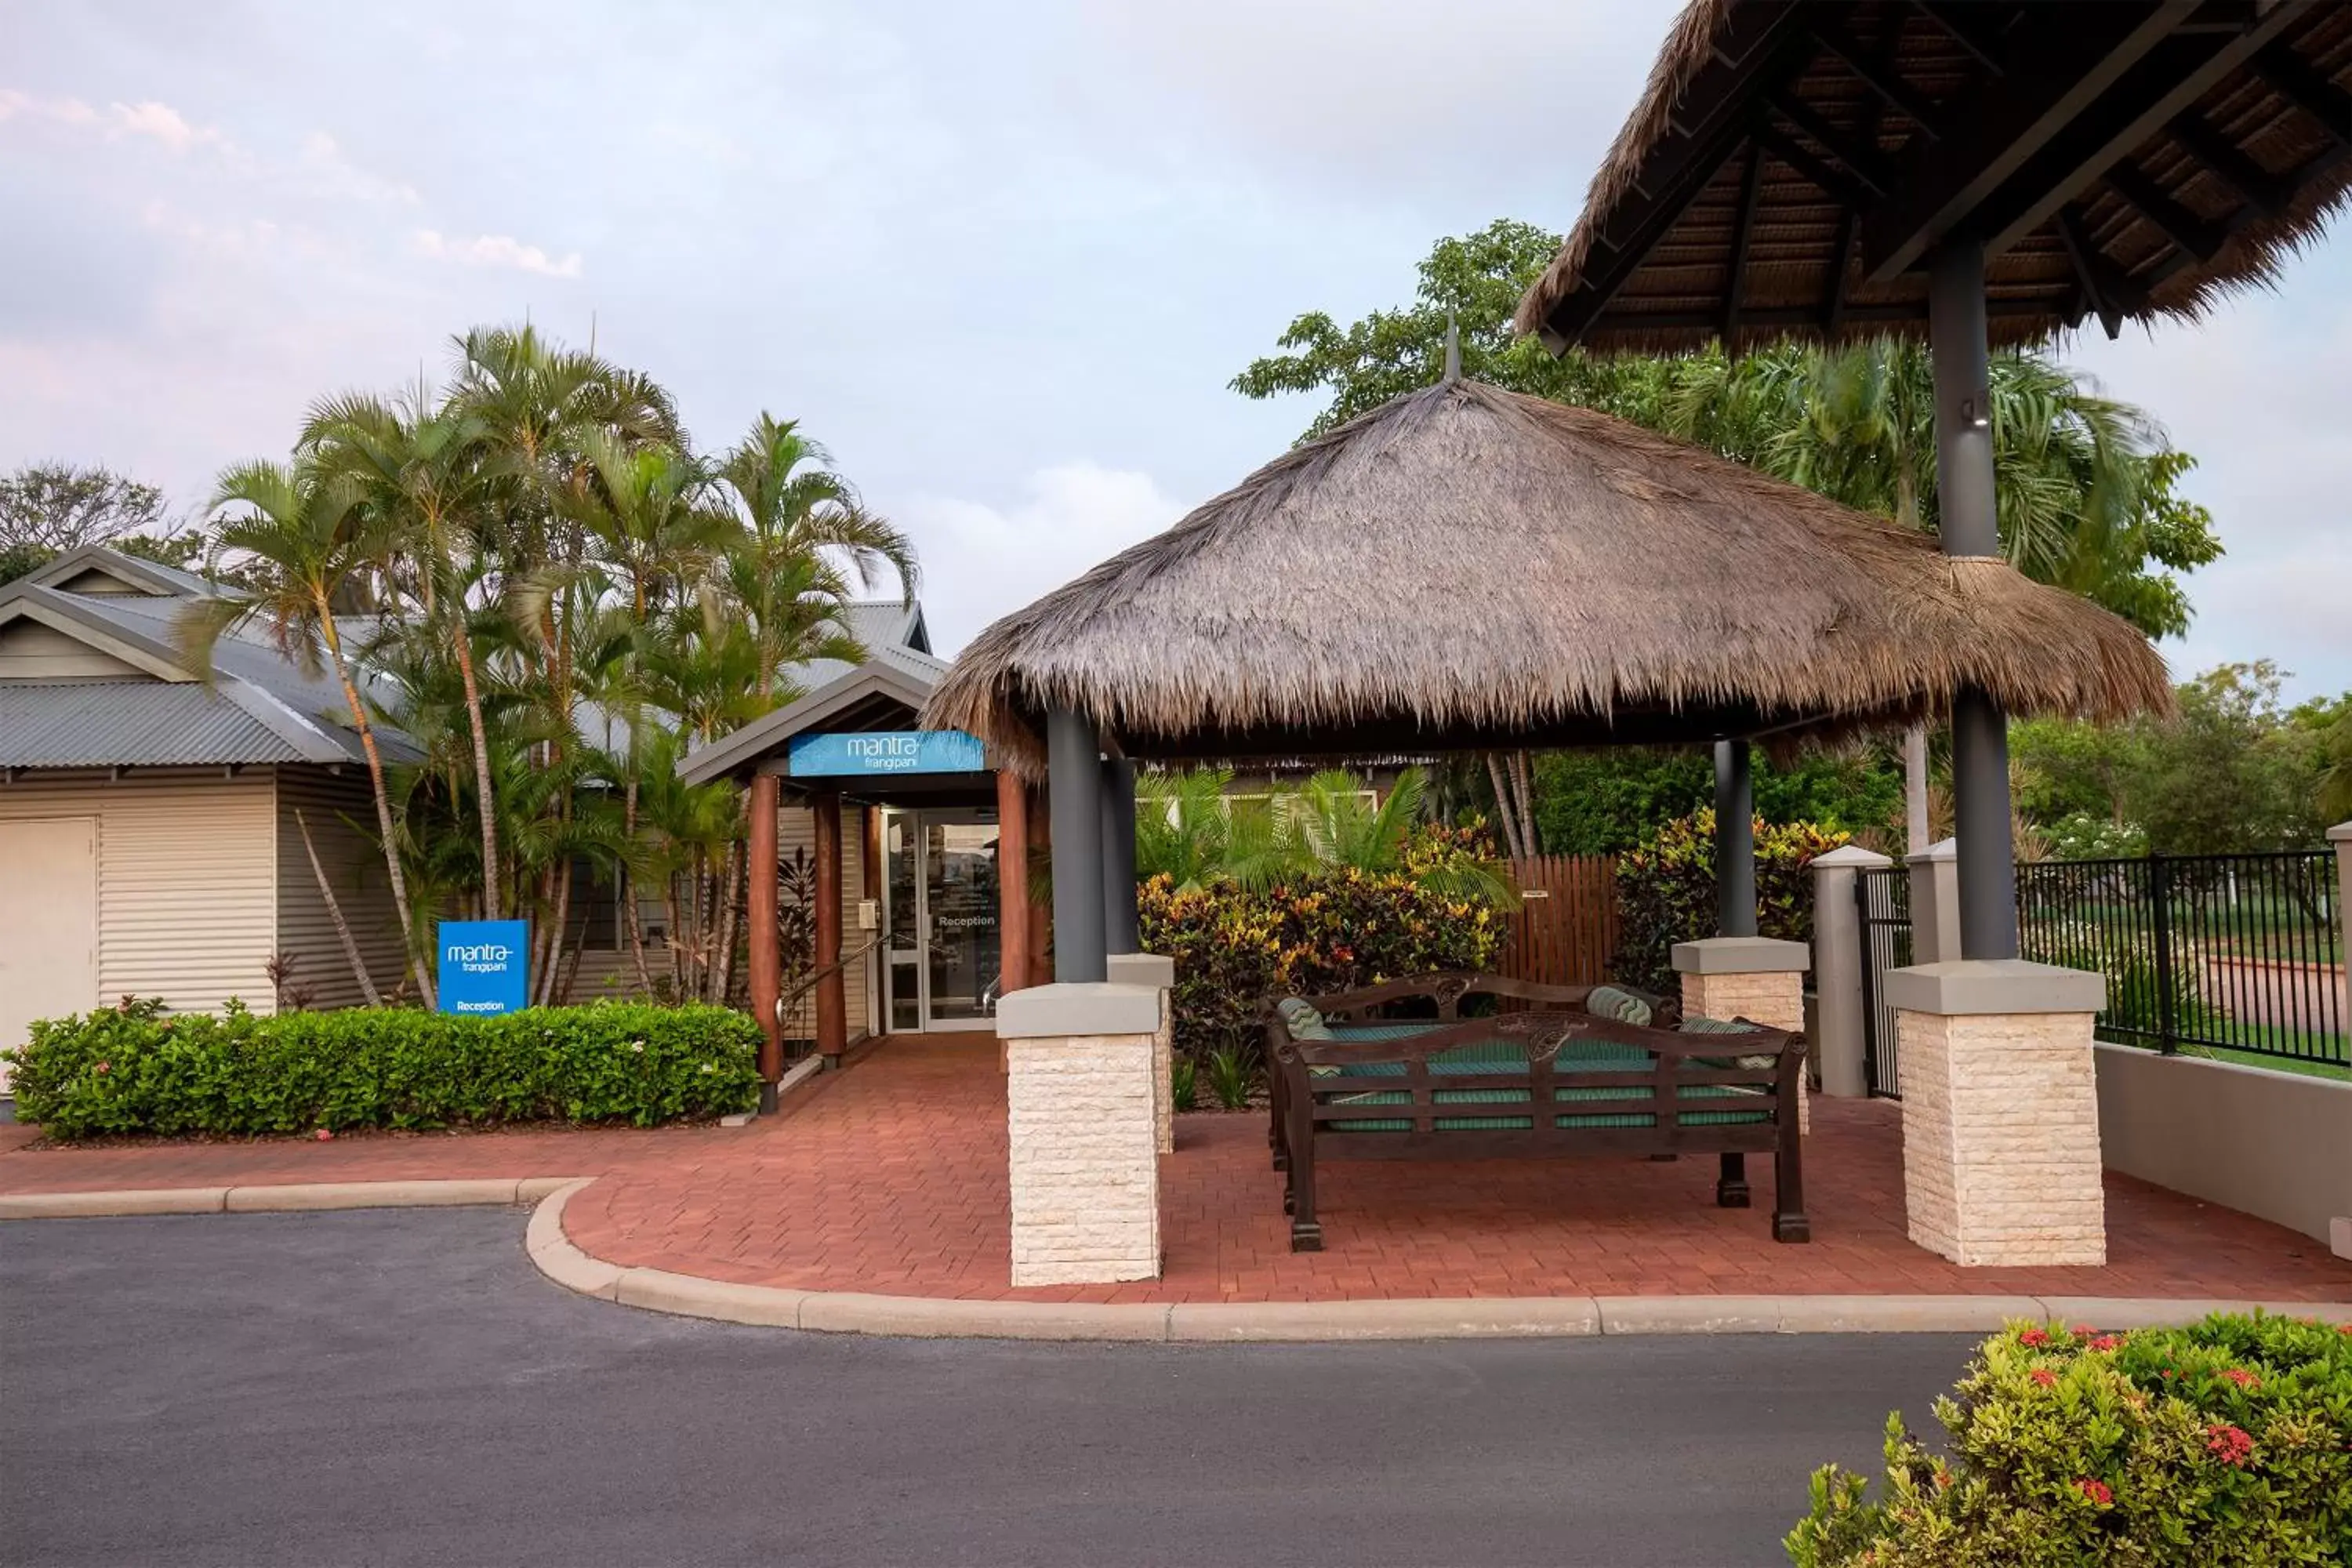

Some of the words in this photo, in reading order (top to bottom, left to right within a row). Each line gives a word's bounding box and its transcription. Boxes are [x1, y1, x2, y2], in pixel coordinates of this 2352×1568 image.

[848, 735, 919, 757] mantra
[865, 757, 916, 771] frangipani
[939, 916, 995, 928] Reception
[448, 943, 514, 963] mantra
[457, 1000, 504, 1012] Reception
